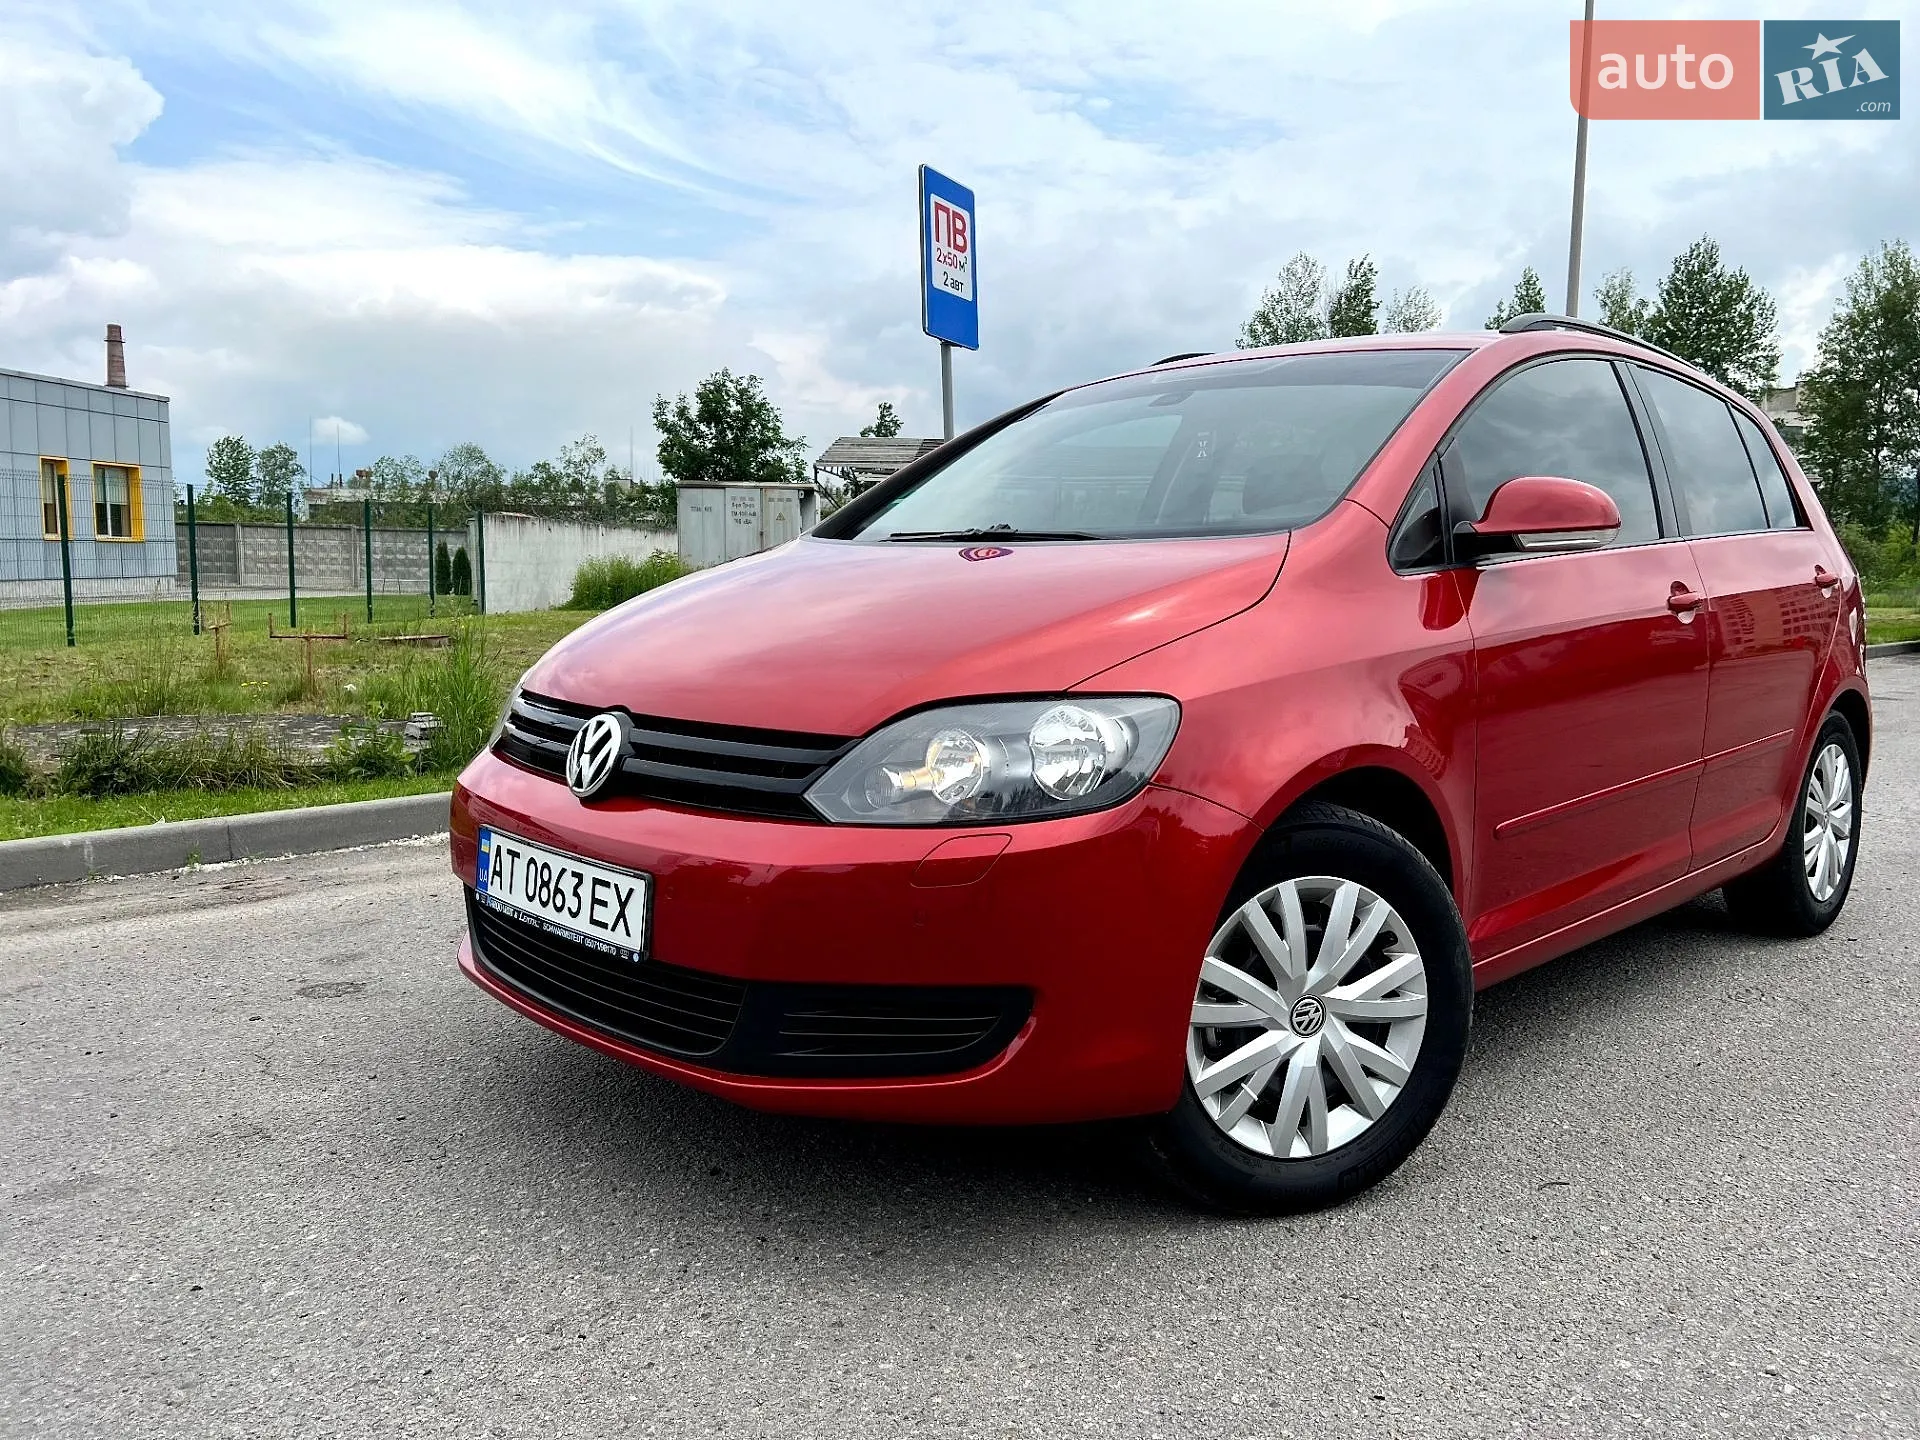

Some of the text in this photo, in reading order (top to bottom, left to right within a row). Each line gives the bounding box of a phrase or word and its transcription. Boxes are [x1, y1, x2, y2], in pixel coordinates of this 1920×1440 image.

[934, 200, 968, 254] ПВ
[943, 271, 949, 287] 2
[479, 869, 488, 883] UA
[490, 844, 635, 938] AT 0863 EX
